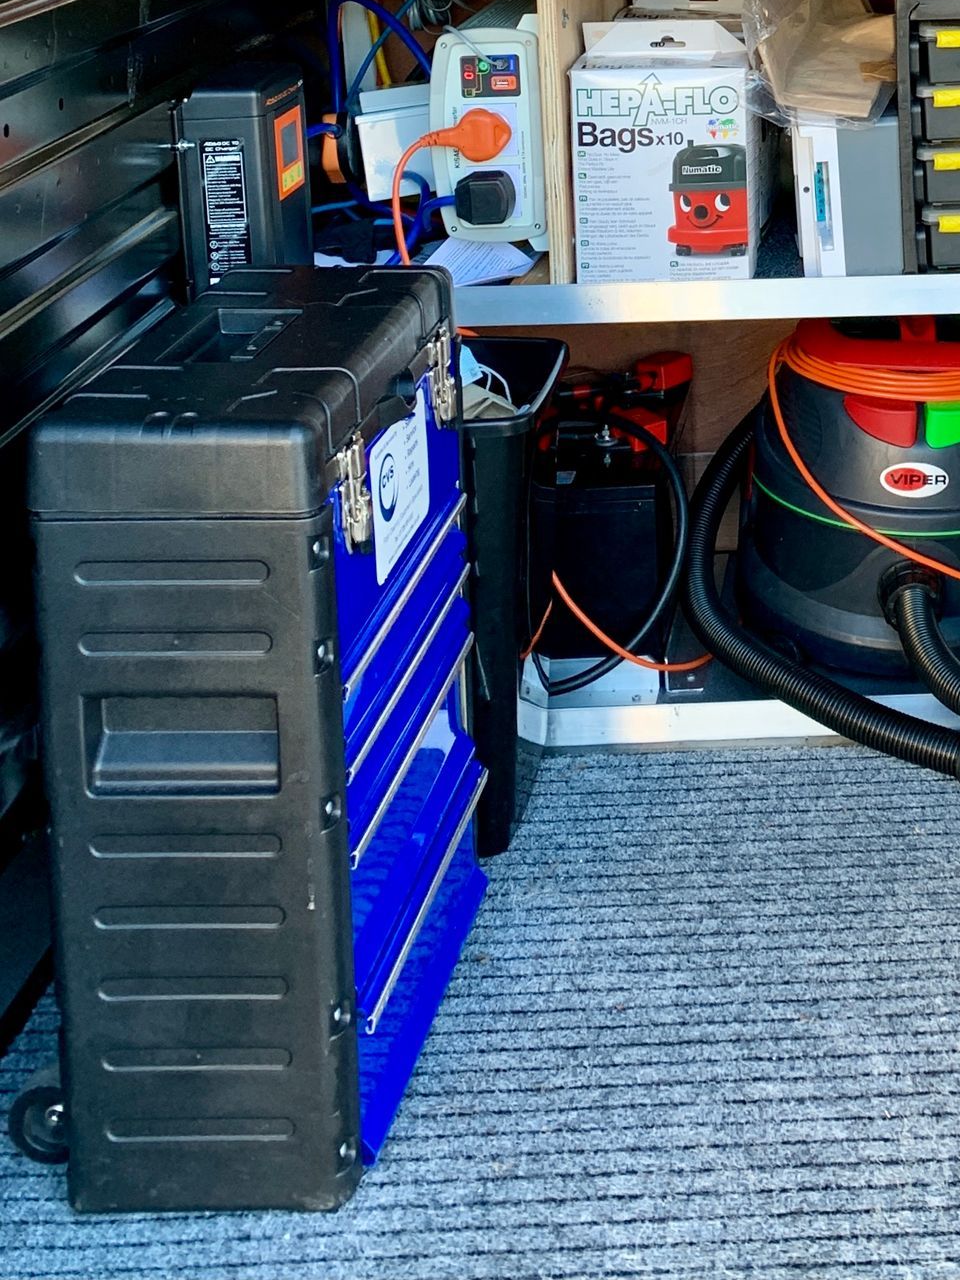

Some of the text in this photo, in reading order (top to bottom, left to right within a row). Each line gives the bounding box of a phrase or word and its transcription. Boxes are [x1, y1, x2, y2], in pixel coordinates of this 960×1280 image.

[576, 77, 739, 124] HEPA-FLO
[577, 122, 684, 153] Bags x10
[682, 164, 723, 175] Numatic
[382, 465, 395, 489] CVS
[890, 473, 948, 486] VIPER
